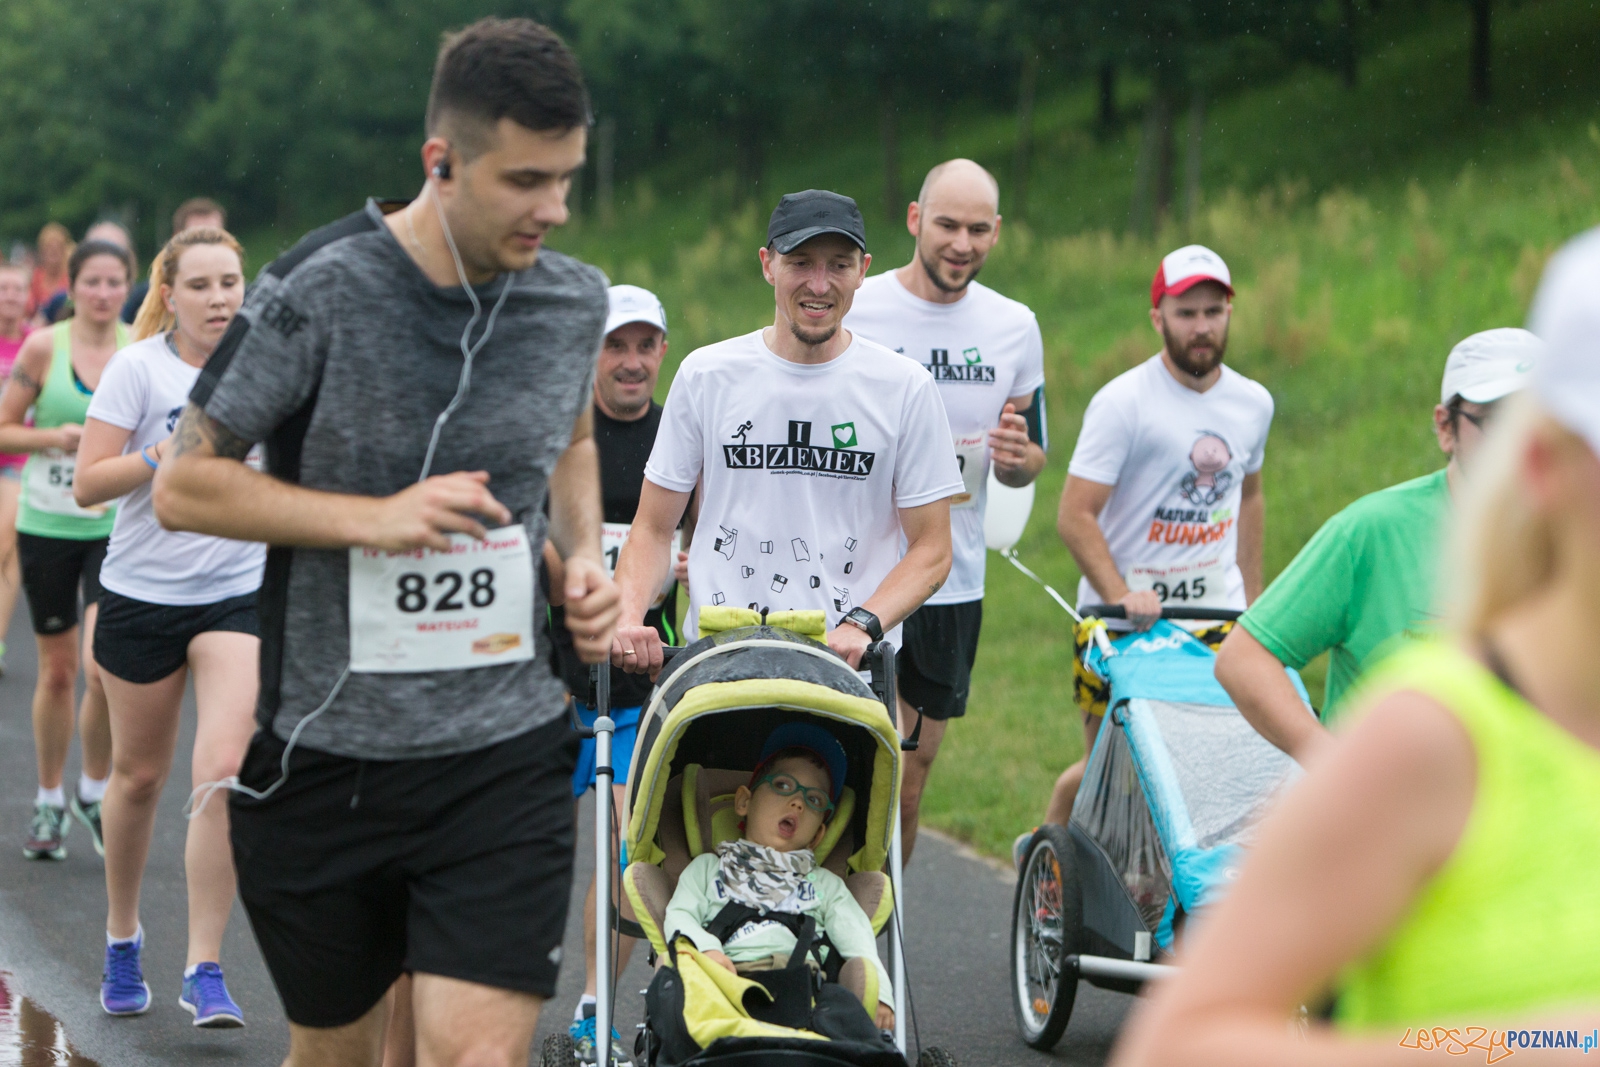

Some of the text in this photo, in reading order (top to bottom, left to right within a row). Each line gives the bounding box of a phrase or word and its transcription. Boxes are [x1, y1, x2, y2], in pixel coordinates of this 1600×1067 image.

[925, 365, 995, 381] IEMEK
[726, 446, 875, 475] KB ZIEMEK
[396, 568, 496, 614] 828
[1152, 576, 1206, 603] 945
